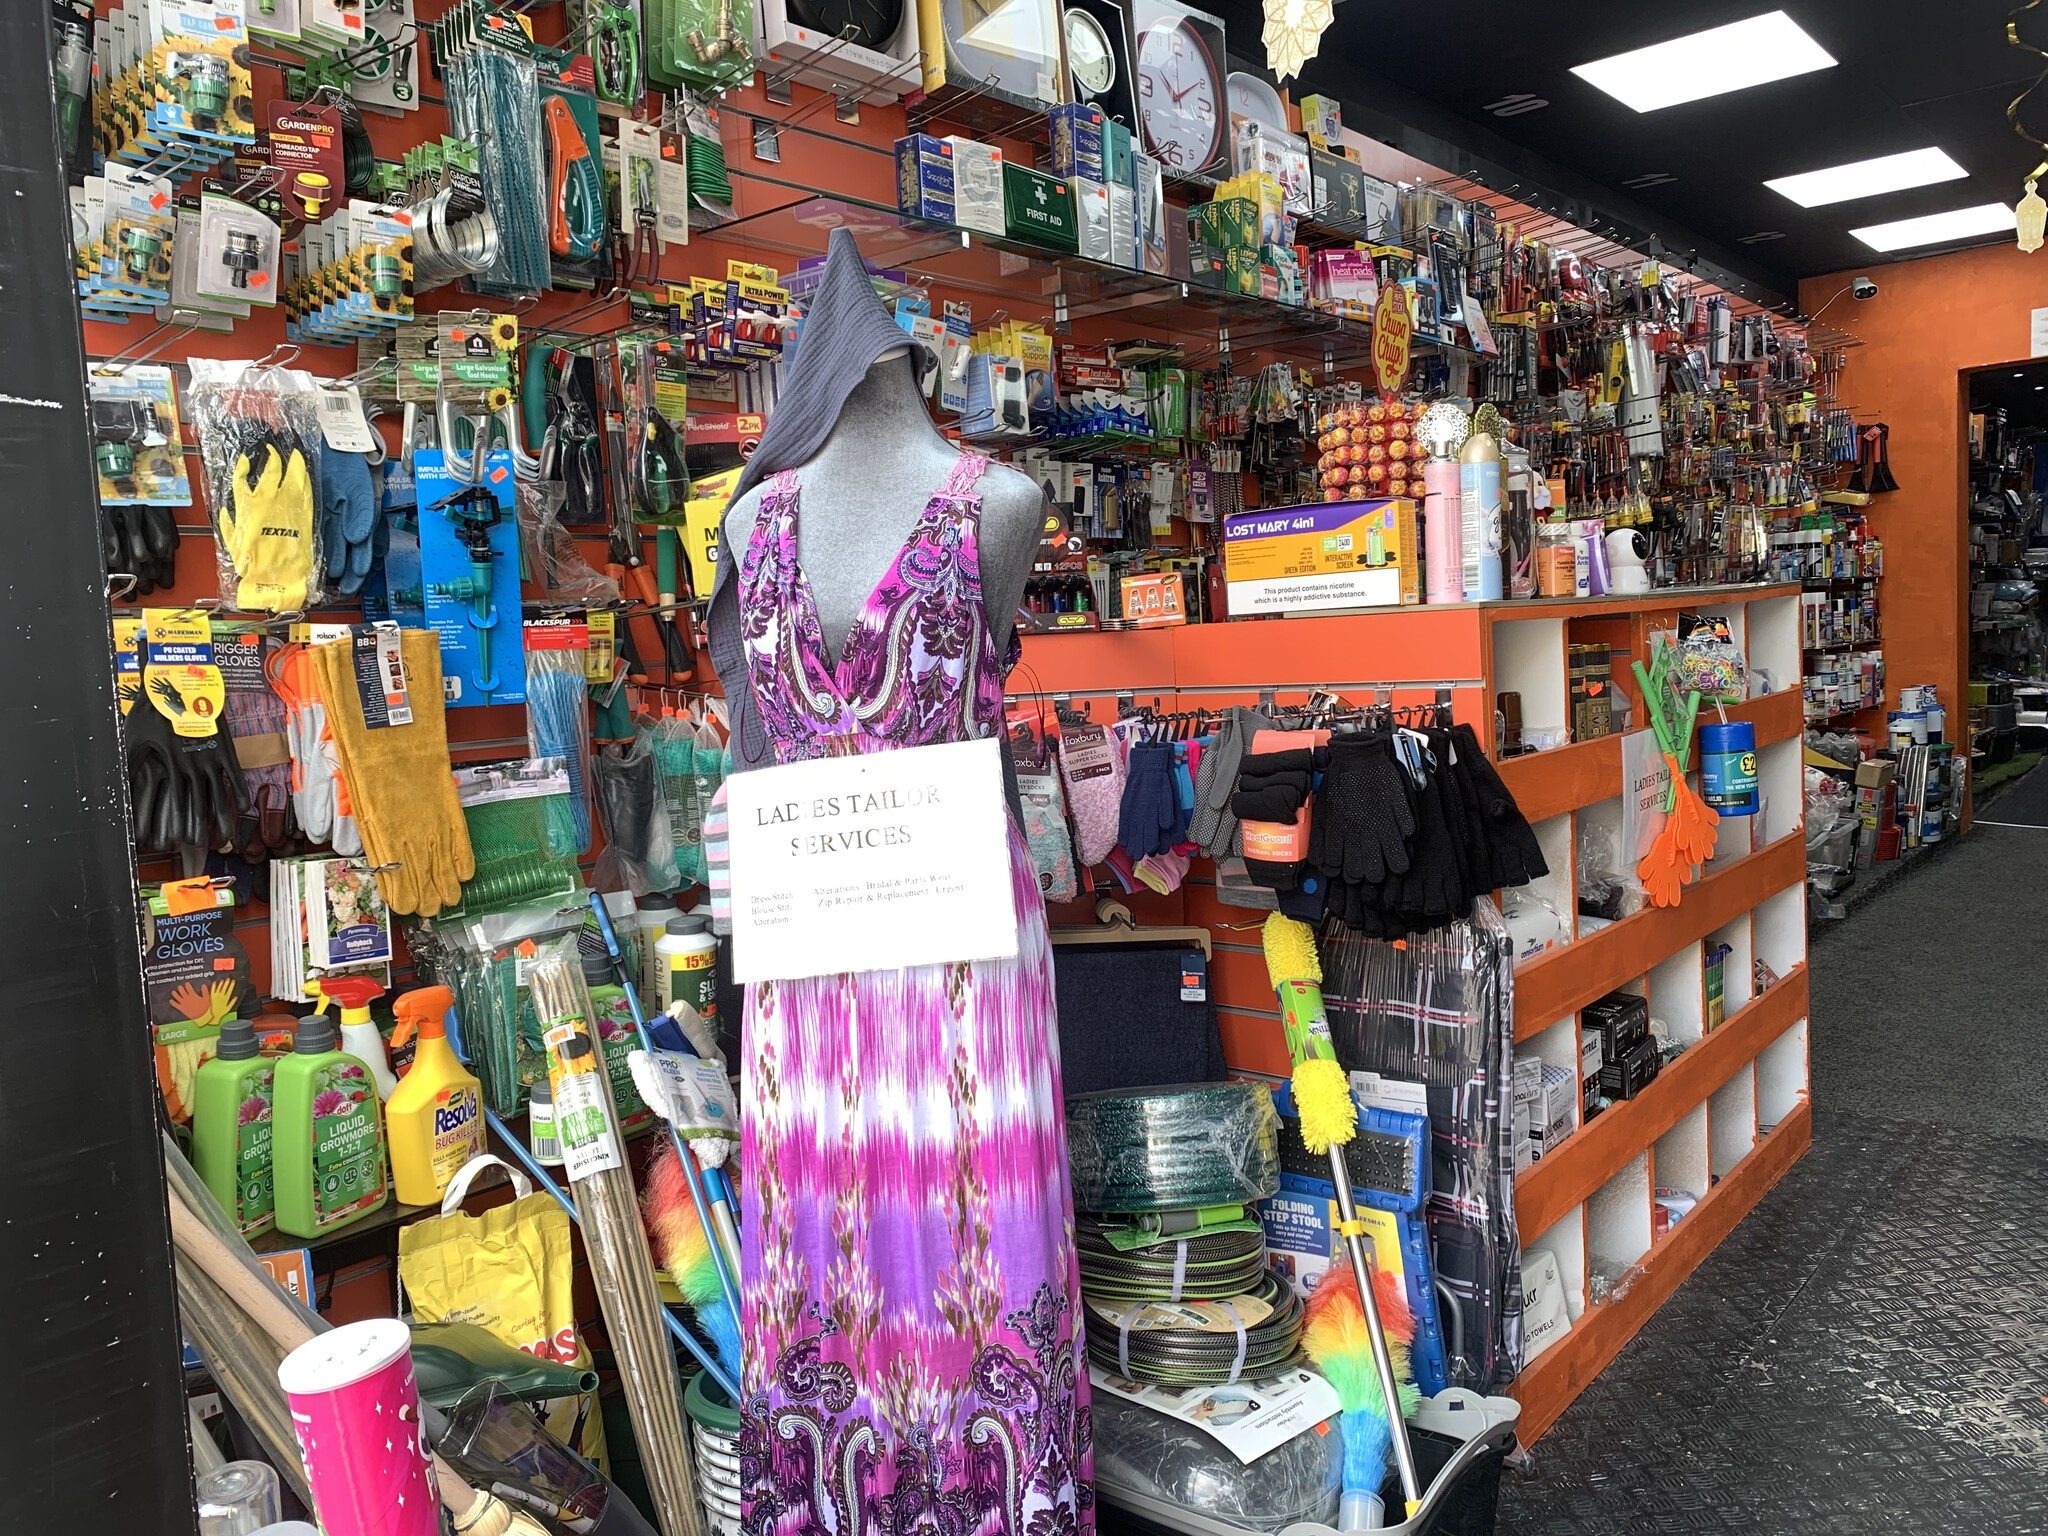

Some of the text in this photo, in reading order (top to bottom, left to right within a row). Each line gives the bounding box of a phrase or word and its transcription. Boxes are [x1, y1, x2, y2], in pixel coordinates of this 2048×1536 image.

[397, 86, 410, 98] 3
[545, 80, 587, 93] PRUNING SAW
[281, 119, 335, 135] GARDENPRO
[274, 142, 320, 154] THREADED TAP
[274, 149, 313, 160] CONNECTOR
[450, 172, 481, 188] GARDEN
[205, 203, 254, 217] Tap Connector
[1026, 207, 1063, 227] FIRST AID
[1240, 248, 1258, 259] LEMSIP
[1332, 265, 1373, 279] heat pads
[744, 285, 785, 301] ULTRA POWER
[742, 300, 771, 312] Mouse Traps
[1380, 308, 1407, 343] Chupa
[1025, 344, 1045, 352] SPORTS
[1377, 333, 1404, 366] Chups
[1022, 350, 1050, 362] Supports
[413, 364, 434, 373] Large
[456, 363, 507, 373] Large Galvanised
[466, 371, 499, 380] Tool Hooks
[478, 390, 485, 403] 4
[1226, 516, 1314, 538] LOST MARY 4in1
[1324, 553, 1354, 563] INTERACTIVE
[1053, 561, 1084, 571] 12PCS
[1284, 564, 1317, 574] GREEN EDITION
[1335, 560, 1354, 570] SCREEN
[1264, 581, 1355, 595] This product contains nicotine
[1254, 597, 1272, 605] which
[1283, 594, 1302, 604] highly
[1303, 592, 1332, 601] addictive
[1332, 590, 1368, 600] substance.
[522, 618, 571, 627] BLACKSPUR
[213, 634, 237, 642] HEAVY
[316, 632, 337, 640] rolson
[356, 636, 377, 647] BBQ
[163, 646, 197, 654] PU COATED
[213, 643, 259, 656] RIGGER
[154, 654, 208, 662] BUILDERS GLOVES
[214, 655, 261, 668] GLOVES
[198, 699, 208, 712] 9
[1068, 752, 1108, 766] SLIPPER SOCKS
[1077, 749, 1097, 758] LADIES
[1742, 756, 1756, 772] £2
[1634, 773, 1656, 793] LADIES
[846, 784, 943, 814] TAILOR
[1639, 789, 1667, 812] SERVICES
[791, 824, 913, 857] SERVICES
[1245, 830, 1293, 844] HeatGuard
[1247, 847, 1271, 856] THERMAL
[876, 887, 929, 902] Replacement
[156, 910, 223, 927] MULTI-PURPOSE
[157, 921, 213, 943] WORK
[156, 936, 225, 960] GLOVES
[346, 938, 373, 949] Hollyhock
[158, 960, 186, 971] protection
[684, 954, 709, 969] 15%
[182, 964, 204, 974] builders
[156, 977, 176, 985] coated
[184, 972, 203, 981] added
[203, 971, 215, 979] grip
[699, 980, 717, 994] SLU
[160, 1029, 188, 1042] LARGE
[610, 1031, 625, 1042] doff
[605, 1043, 637, 1060] LIQUID
[659, 1059, 679, 1070] PRO
[662, 1067, 682, 1076] KLEEN
[336, 1102, 353, 1115] doff
[434, 1092, 478, 1137] Resolva
[329, 1114, 366, 1138] LIQUID
[320, 1122, 375, 1153] GROWMORE
[435, 1120, 478, 1150] BUG KILLER
[338, 1140, 361, 1158] 7-7-7
[328, 1148, 373, 1172] Extra CONCENTRATE
[1271, 1198, 1315, 1216] FOLDING
[1263, 1209, 1325, 1230] STEP STOOL
[1295, 1232, 1312, 1241] storage.
[511, 1315, 537, 1334] Caring
[1530, 1318, 1555, 1340] TOWELS
